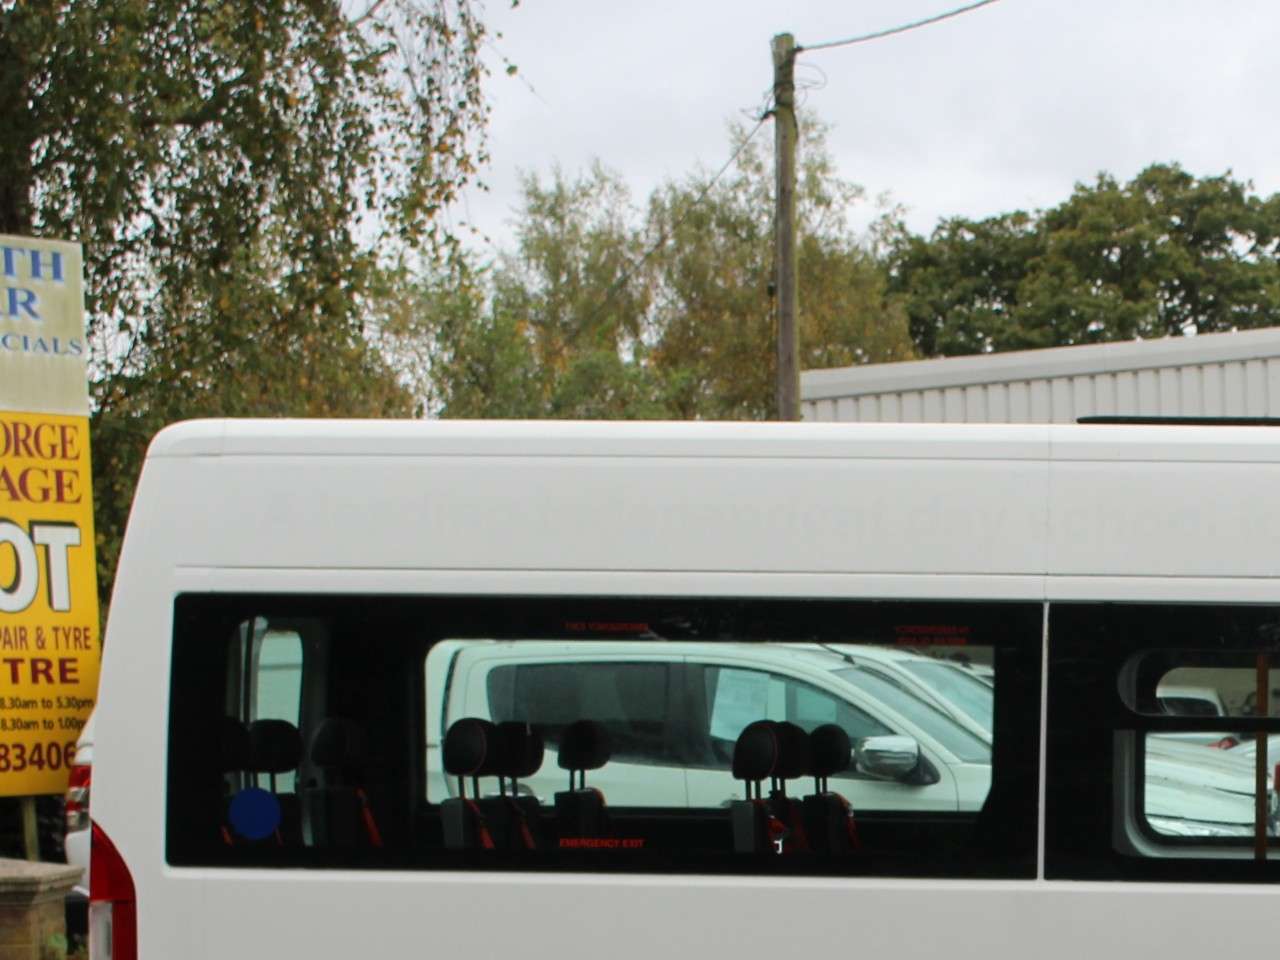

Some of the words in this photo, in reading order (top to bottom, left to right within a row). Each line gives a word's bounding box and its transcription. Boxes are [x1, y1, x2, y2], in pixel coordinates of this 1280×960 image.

[35, 626, 46, 650] &
[52, 627, 91, 650] TYRE
[2, 657, 80, 685] TRE
[41, 697, 53, 709] to
[42, 718, 54, 731] to
